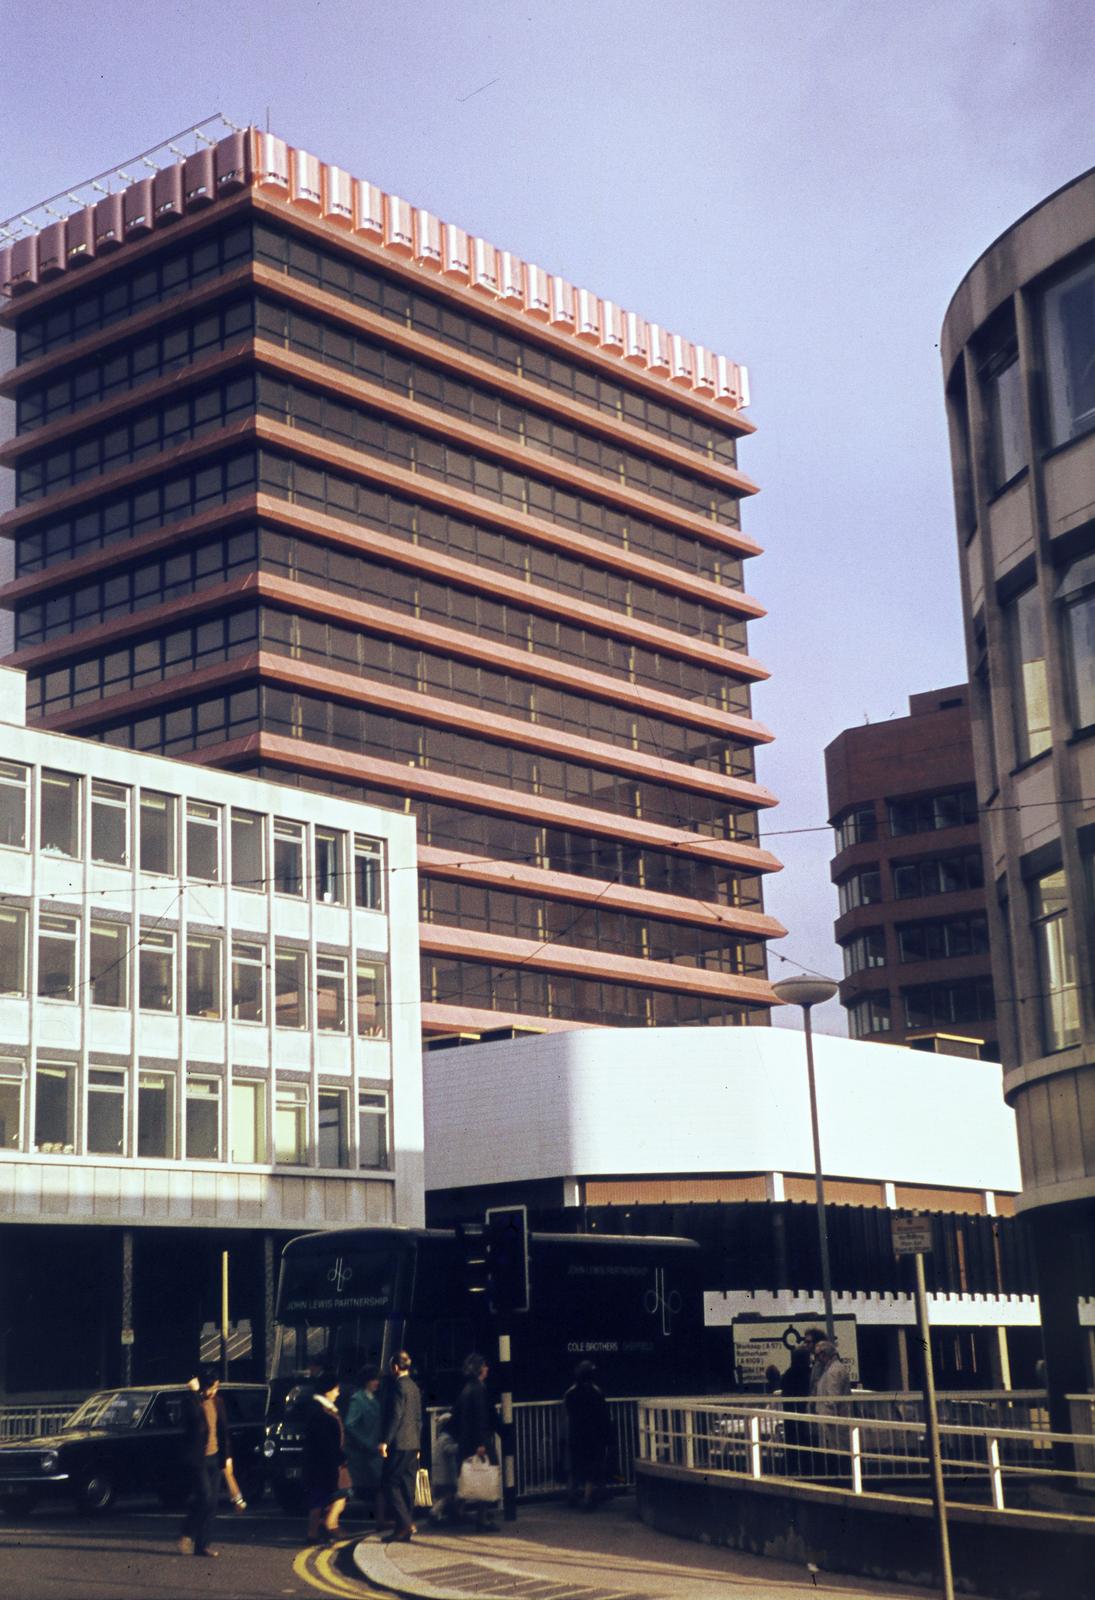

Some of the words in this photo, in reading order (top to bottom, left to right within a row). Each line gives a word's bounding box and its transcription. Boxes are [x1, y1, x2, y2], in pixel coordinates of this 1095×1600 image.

[308, 1298, 333, 1310] LEWIS
[334, 1295, 389, 1308] PARTNERSHIP
[567, 1341, 585, 1353] COLE
[585, 1341, 619, 1353] BROTHERS
